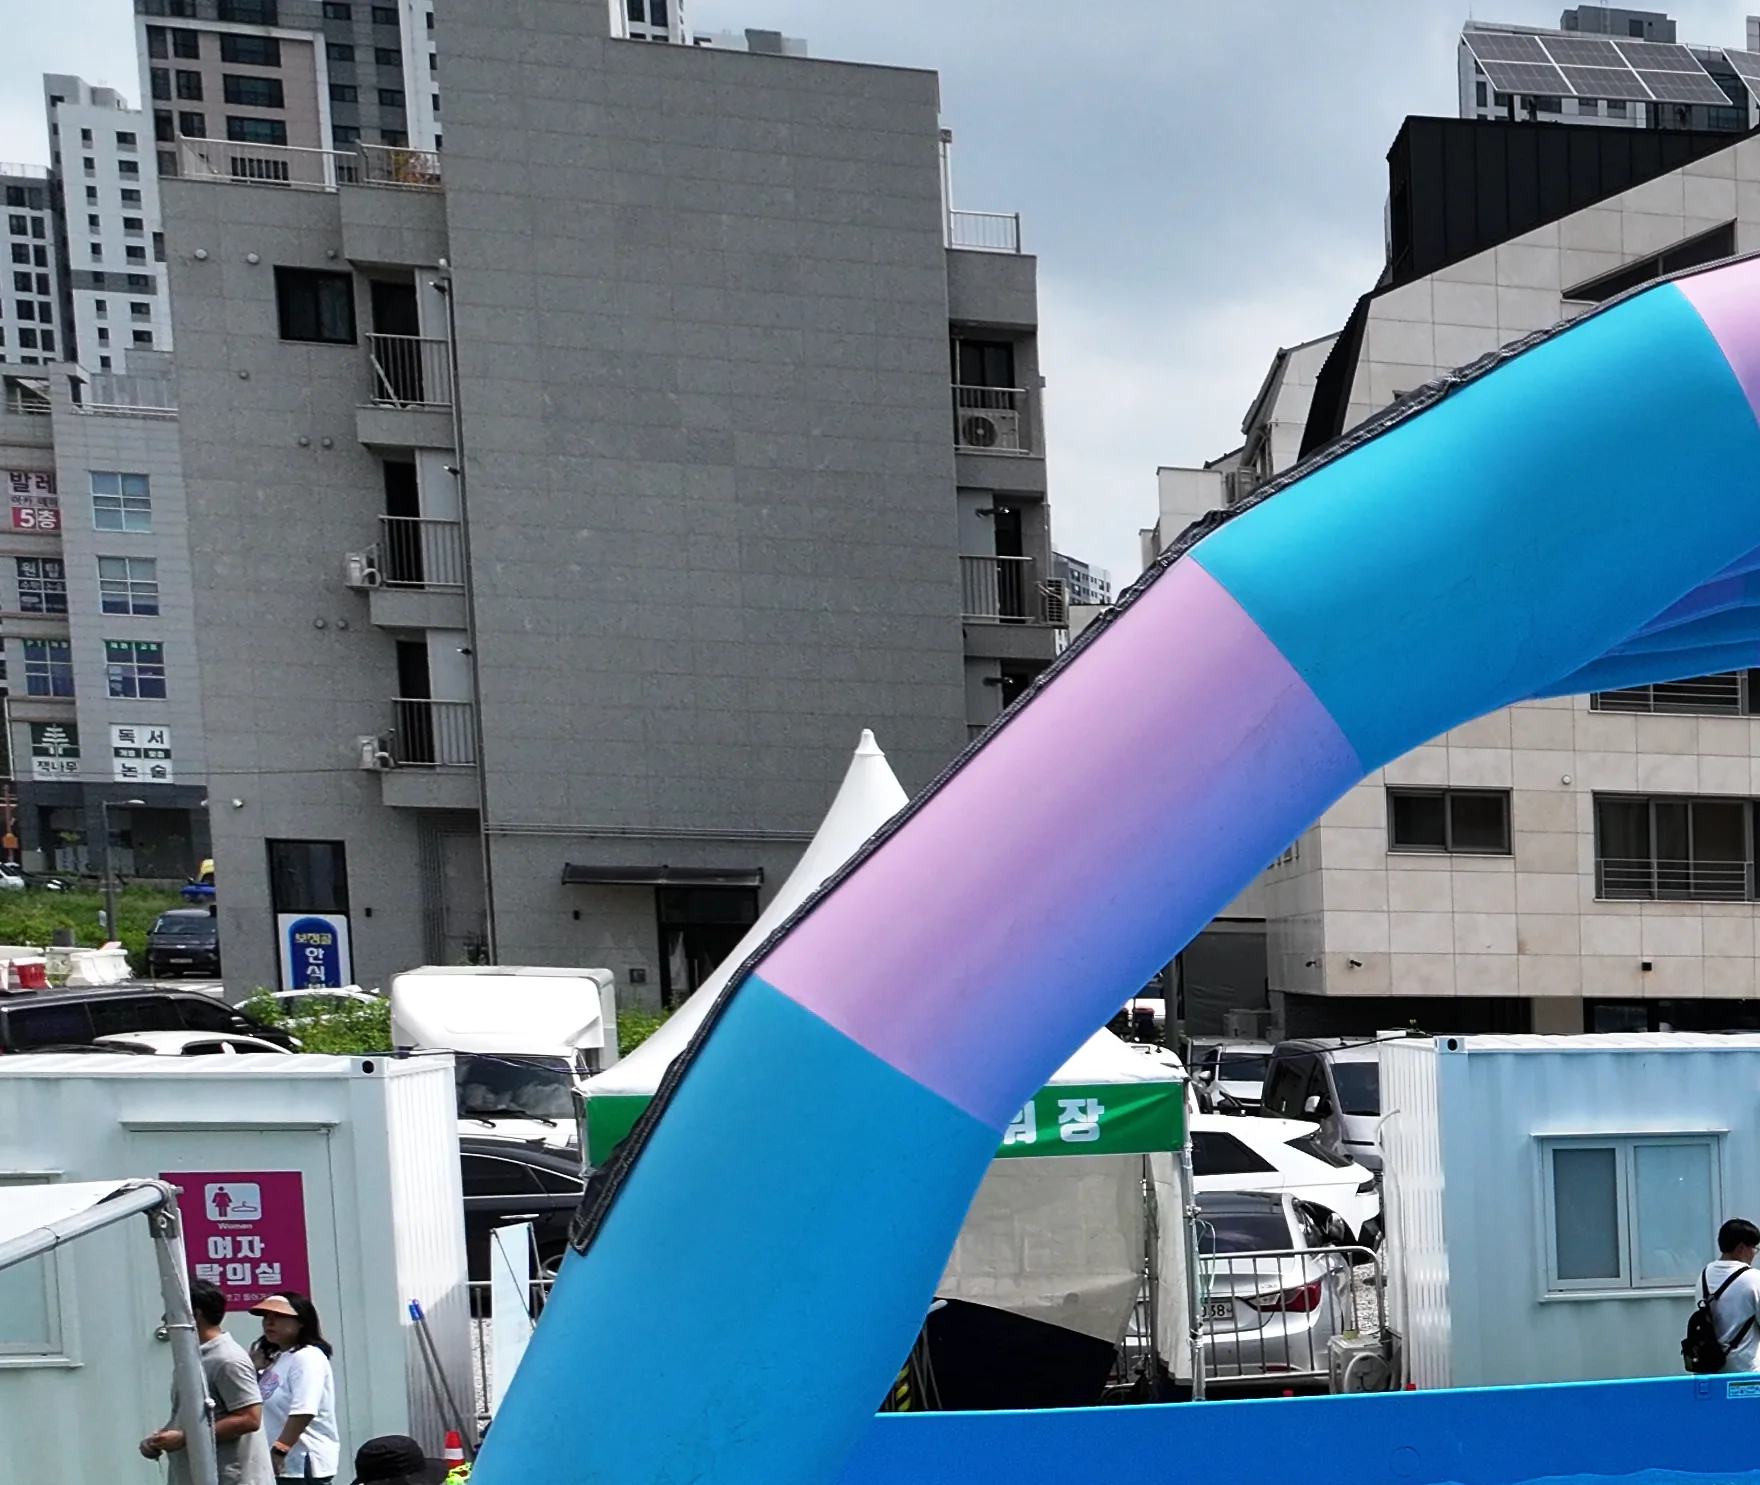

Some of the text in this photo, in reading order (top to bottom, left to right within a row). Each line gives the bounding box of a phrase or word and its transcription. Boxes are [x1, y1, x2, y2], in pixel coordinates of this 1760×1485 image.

[10, 472, 57, 495] 발레
[20, 509, 57, 529] 5층
[118, 729, 165, 745] 독서
[121, 763, 167, 779] 논술
[207, 1236, 265, 1259] 여자
[195, 1262, 282, 1286] 탈의실
